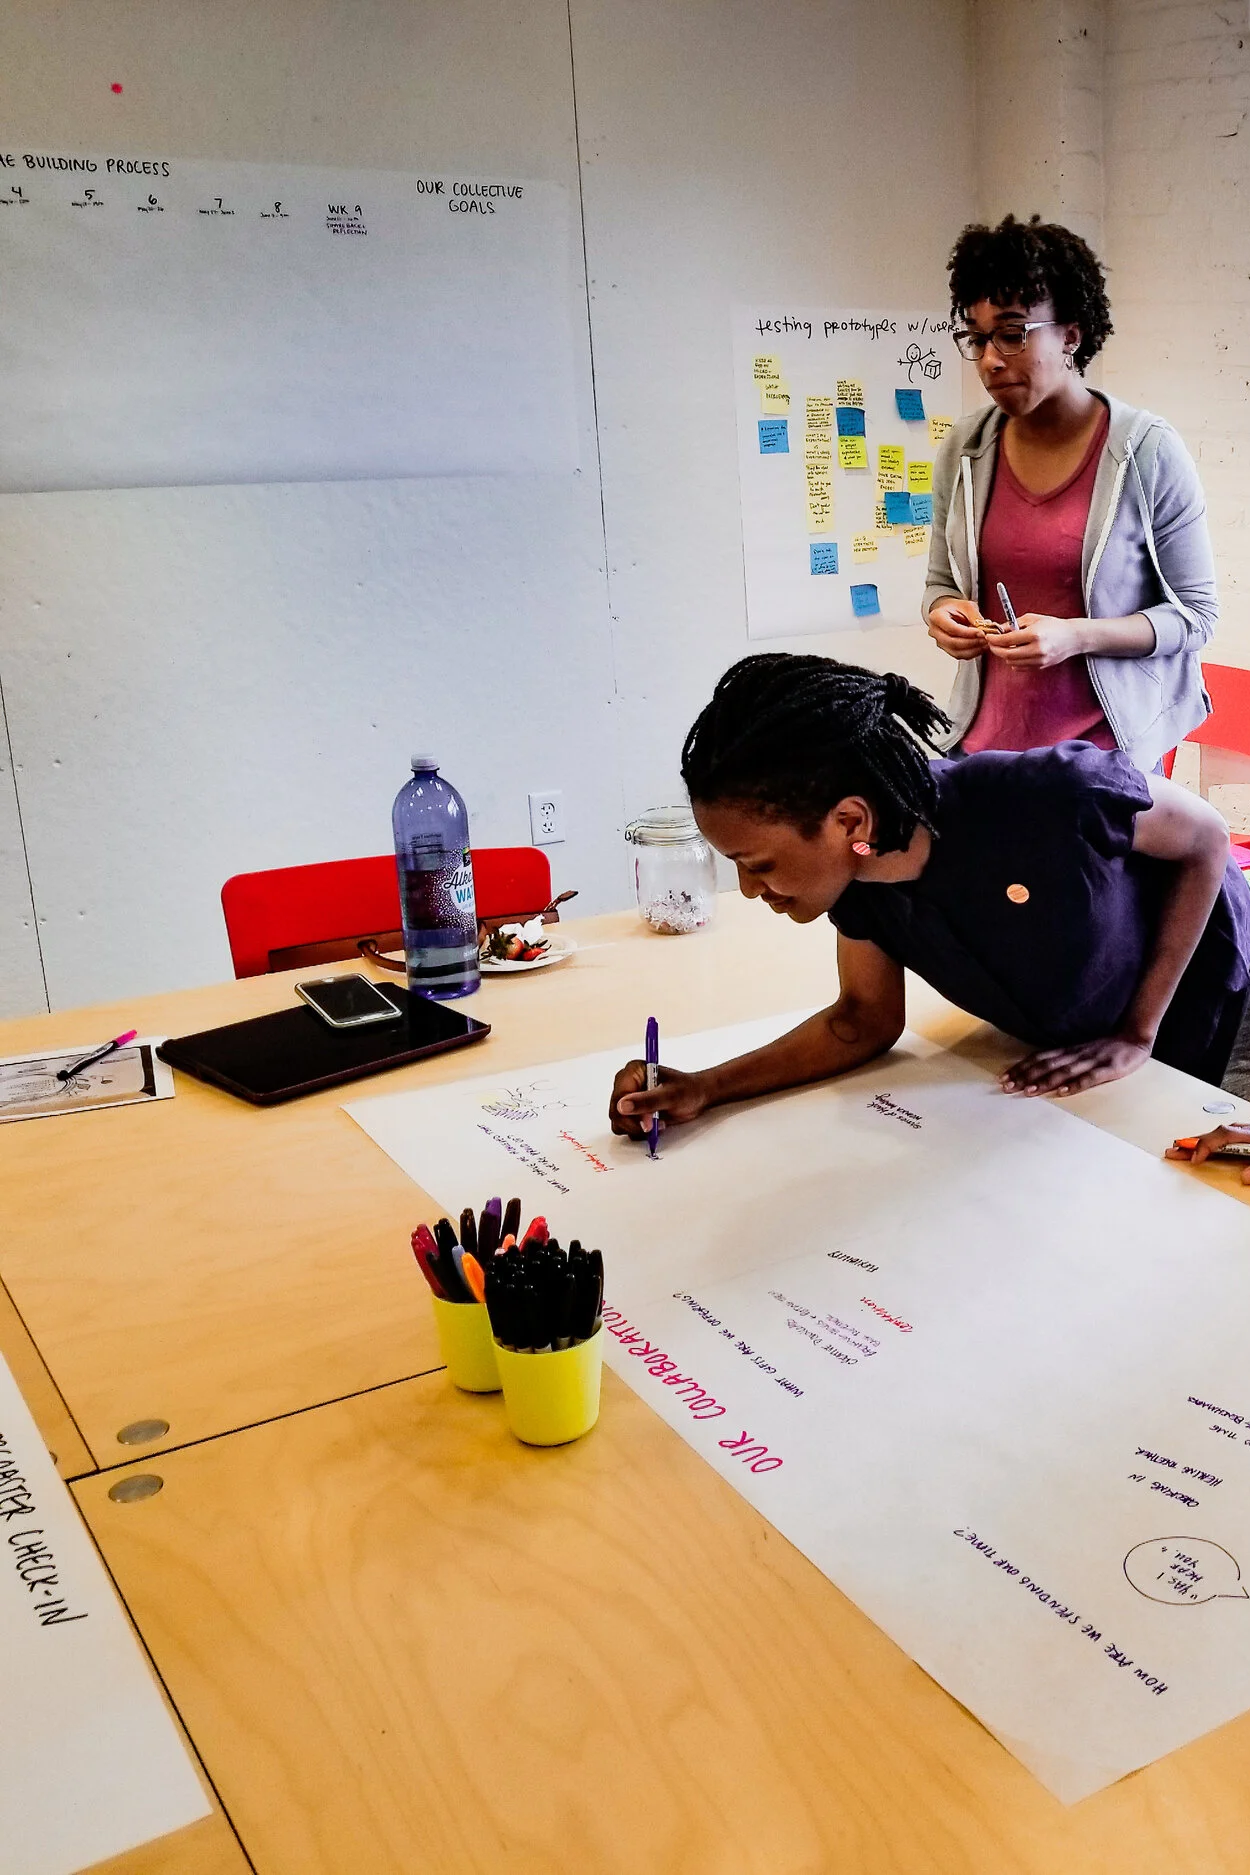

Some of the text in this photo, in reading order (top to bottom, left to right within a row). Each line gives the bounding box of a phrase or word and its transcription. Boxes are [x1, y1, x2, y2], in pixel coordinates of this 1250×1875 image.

[23, 154, 98, 173] BUILDING
[106, 158, 170, 177] PROCESS
[12, 186, 23, 197] 4
[84, 189, 96, 201] 5
[416, 179, 524, 198] OUR COLLECTIVE
[148, 194, 158, 206] 6
[214, 198, 223, 209] 7
[274, 201, 282, 214] 8
[448, 199, 496, 215] GOALS
[328, 204, 363, 217] WK 9
[755, 316, 812, 338] testing
[824, 318, 897, 340] prototypes
[827, 1250, 879, 1273] FLEXIBILITY
[718, 1329, 735, 1340] WE
[734, 1341, 755, 1355] ARE
[751, 1357, 776, 1374] GIFTS
[775, 1378, 804, 1398] WHAT
[1209, 1425, 1237, 1439] TIME
[718, 1431, 783, 1473] OUR
[1135, 1447, 1223, 1487] HEALING TOGETHER
[1128, 1474, 1199, 1507] CHECKING IN
[8, 1529, 88, 1627] CHECK-IN
[1169, 1564, 1203, 1583] HEAR
[953, 1527, 1168, 1696] HOW ARE WE SPENDING OUR TIME?
